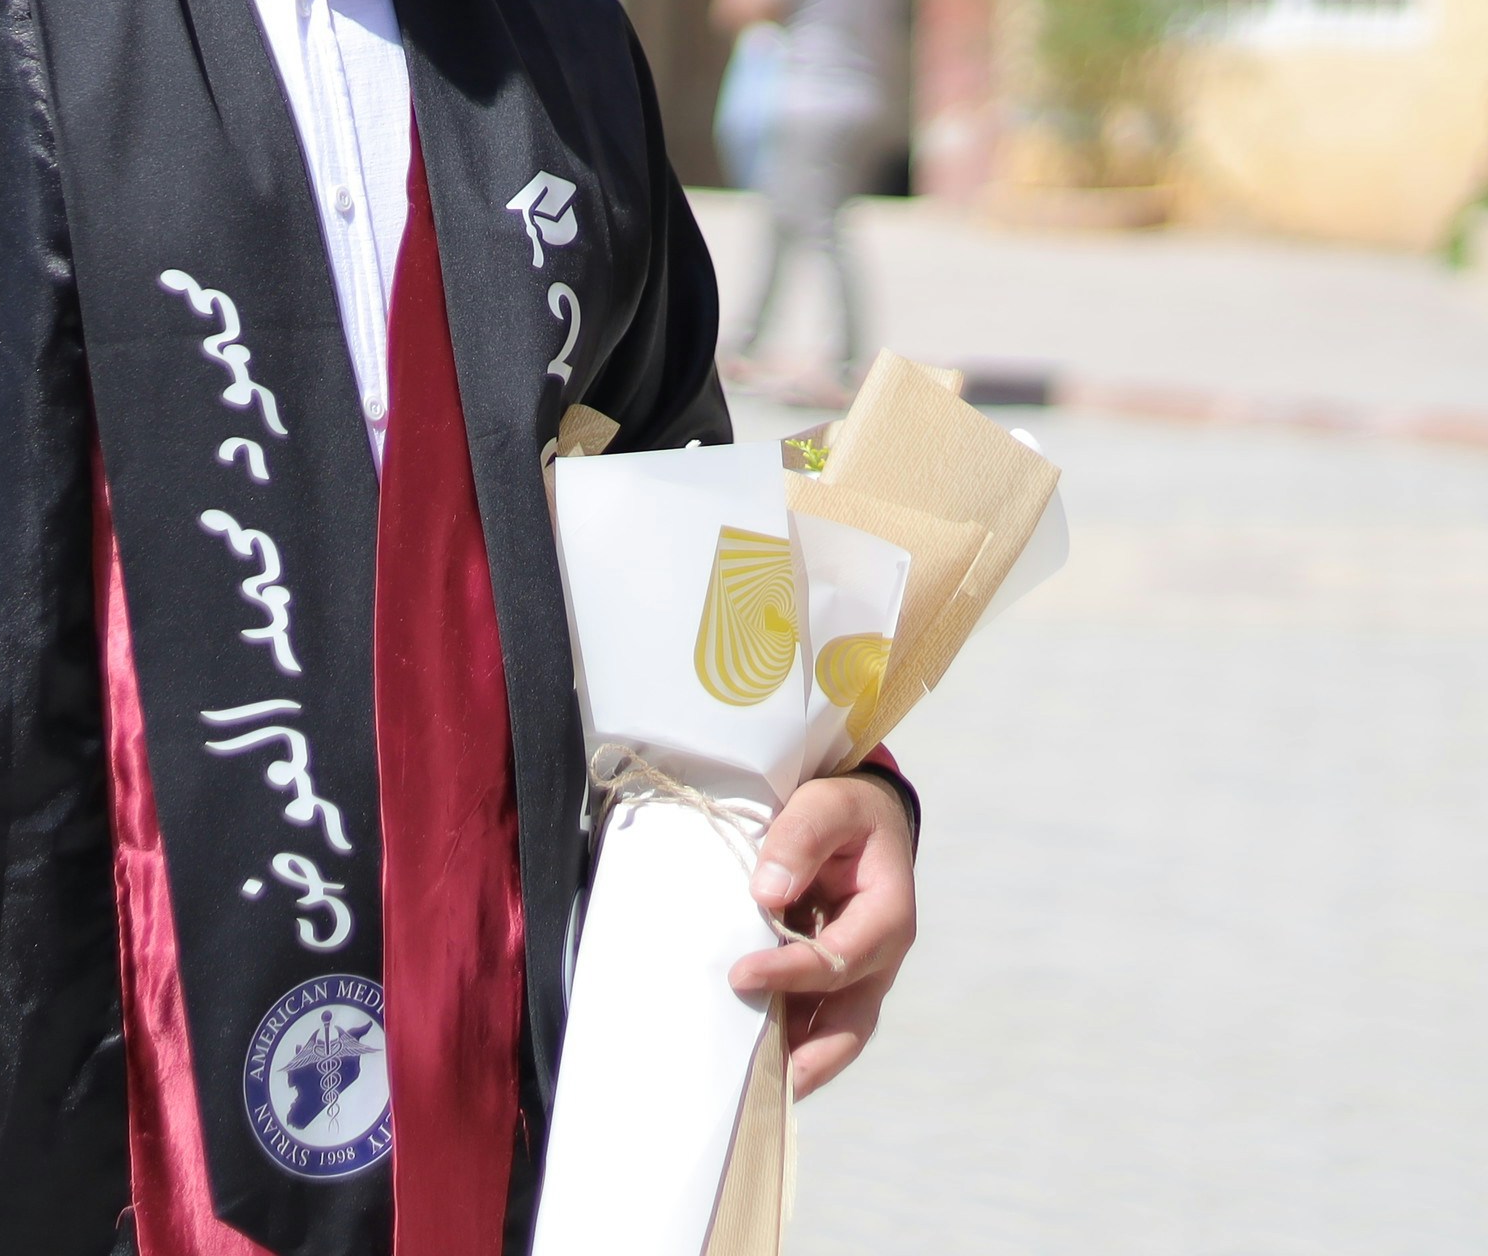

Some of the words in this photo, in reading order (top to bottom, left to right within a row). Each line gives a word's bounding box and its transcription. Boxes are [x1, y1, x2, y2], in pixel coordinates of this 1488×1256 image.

[159, 268, 289, 481] محمود
[200, 509, 302, 674] محمد
[200, 698, 353, 949] العوض
[250, 981, 329, 1082] AMERICAN
[336, 980, 385, 1013] MEDI
[255, 1102, 310, 1167] SYRIAN
[319, 1146, 356, 1165] 1998
